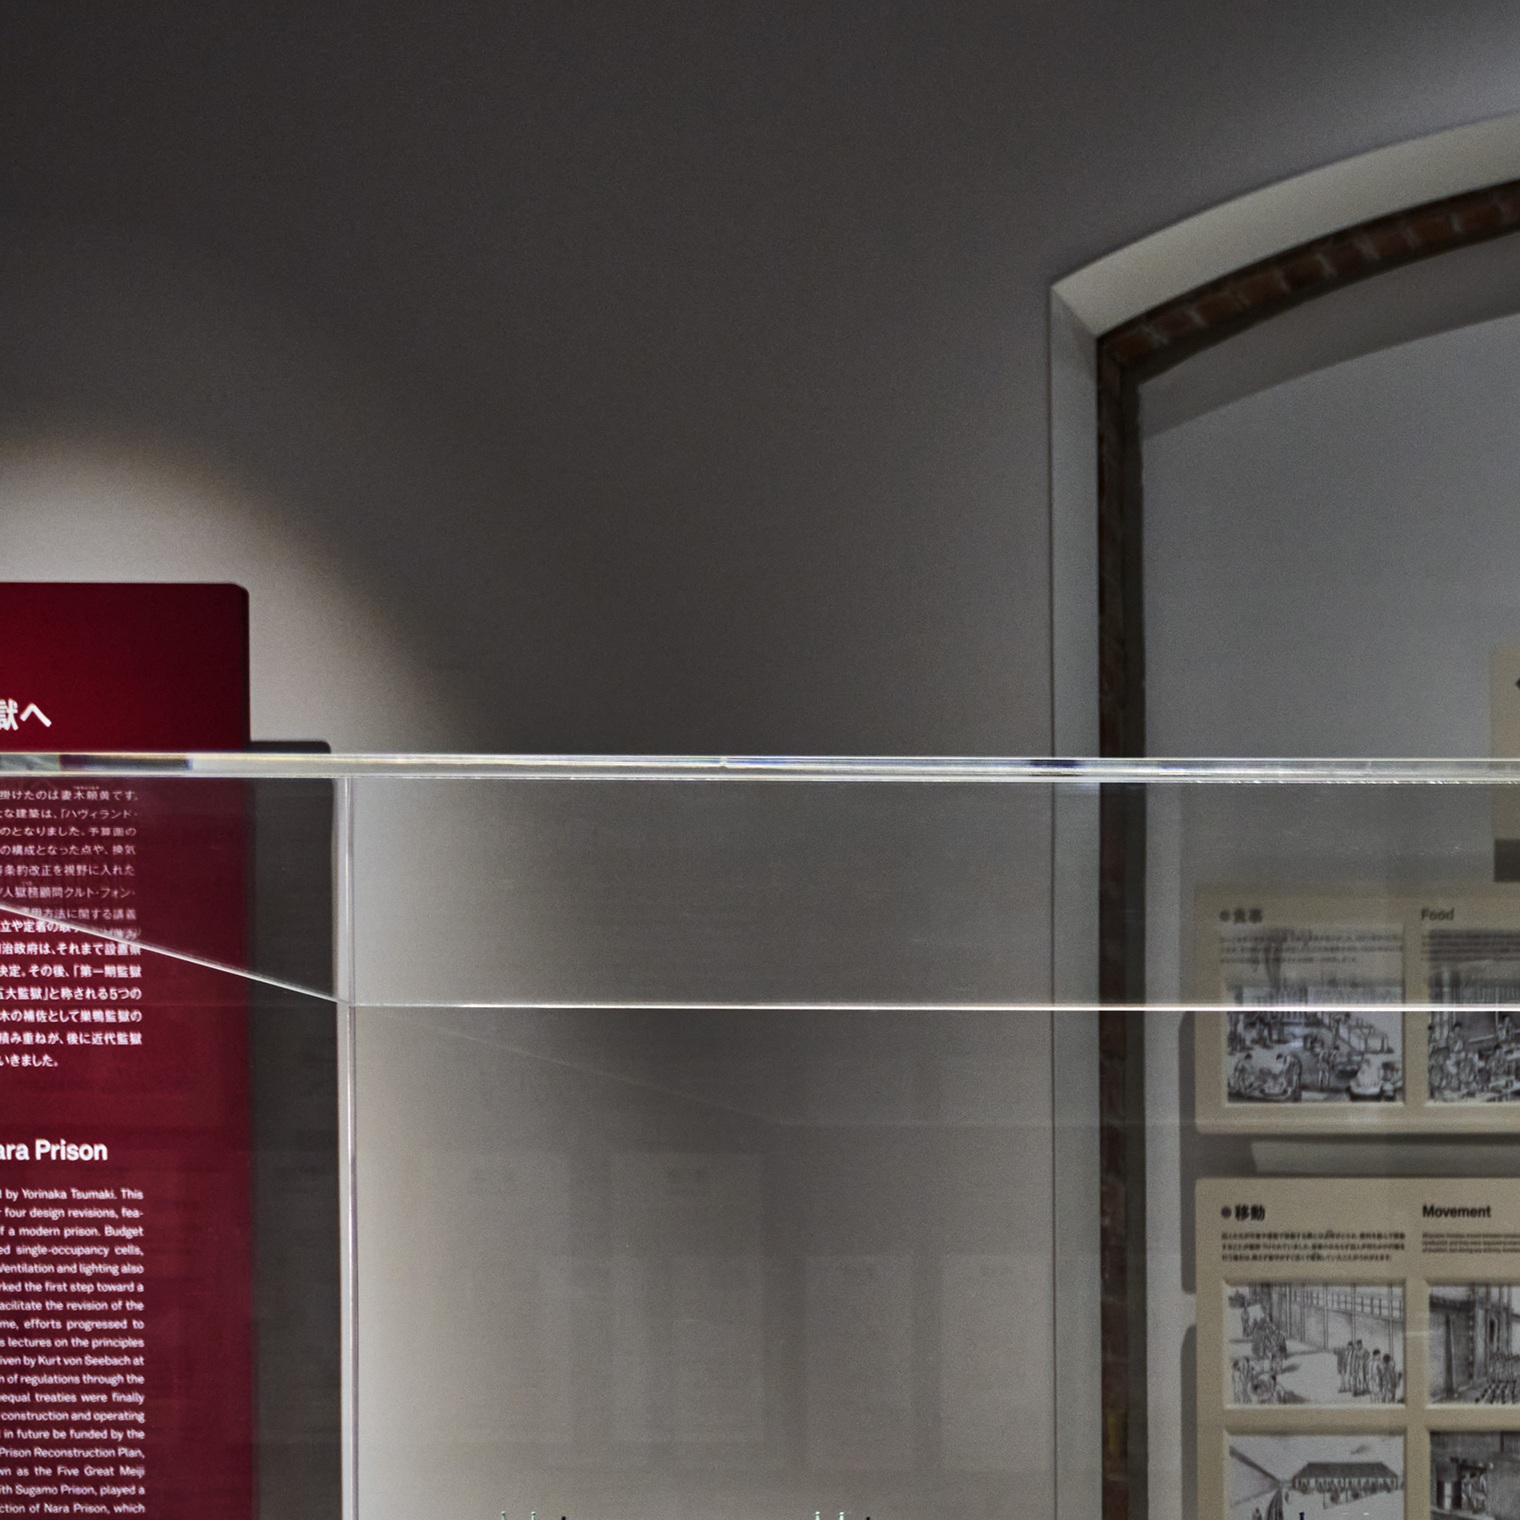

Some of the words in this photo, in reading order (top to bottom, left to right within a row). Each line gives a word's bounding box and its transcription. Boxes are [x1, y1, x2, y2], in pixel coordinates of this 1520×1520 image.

[0, 864, 136, 876] 条約改正を視野に入れた
[1419, 907, 1455, 921] Food
[35, 1138, 108, 1161] Prison
[5, 1188, 19, 1202] by
[70, 1187, 115, 1200] Tsumaki.
[121, 1187, 144, 1200] This
[4, 1206, 27, 1218] four
[29, 1207, 65, 1221] design
[67, 1207, 119, 1219] revisions,
[121, 1206, 143, 1219] fea-
[1235, 1205, 1266, 1222] 移動
[1422, 1205, 1492, 1218] Movement
[7, 1227, 16, 1237] a
[18, 1225, 61, 1237] modern
[63, 1226, 101, 1239] prison.
[103, 1224, 144, 1240] Budget
[15, 1243, 110, 1258] single-occupancy
[114, 1244, 145, 1257] cells,
[56, 1262, 78, 1274] and
[78, 1262, 120, 1277] lighting
[120, 1262, 145, 1274] also
[24, 1281, 43, 1293] the
[44, 1280, 68, 1293] first
[69, 1281, 95, 1294] step
[96, 1281, 135, 1293] toward
[136, 1283, 145, 1293] a
[44, 1299, 64, 1311] the
[65, 1300, 109, 1311] revision
[110, 1299, 123, 1311] of
[125, 1299, 145, 1311] the
[23, 1318, 62, 1330] efforts
[66, 1318, 128, 1332] progressed
[132, 1319, 145, 1330] to
[7, 1336, 53, 1348] lectures
[54, 1338, 69, 1348] on
[70, 1336, 90, 1348] the
[91, 1336, 145, 1350] principles
[23, 1355, 36, 1369] by
[37, 1355, 61, 1366] Kurt
[63, 1356, 83, 1366] von
[84, 1354, 131, 1367] Seebach
[132, 1355, 144, 1366] at
[6, 1373, 19, 1385] of
[20, 1373, 81, 1387] regulations
[82, 1373, 125, 1387] through
[126, 1373, 145, 1385] the
[34, 1392, 77, 1403] treaties
[80, 1393, 108, 1403] were
[111, 1391, 145, 1406] finally
[0, 1410, 69, 1421] construction
[70, 1410, 92, 1421] and
[93, 1410, 146, 1424] operating
[3, 1429, 14, 1439] in
[16, 1428, 50, 1440] future
[52, 1428, 67, 1440] be
[69, 1428, 108, 1440] funded
[110, 1428, 124, 1442] by
[126, 1428, 146, 1440] the
[33, 1446, 116, 1458] Reconstruction
[117, 1446, 146, 1459] Plan,
[15, 1467, 30, 1477] as
[33, 1465, 53, 1477] the
[56, 1465, 80, 1477] Five
[83, 1464, 115, 1477] Great
[15, 1483, 59, 1498] Sugamo
[60, 1483, 98, 1496] Prison,
[99, 1484, 136, 1498] played
[137, 1486, 146, 1495] a
[28, 1503, 41, 1514] of
[43, 1502, 70, 1514] Nara
[72, 1502, 111, 1514] Prison,
[113, 1503, 146, 1514] which
